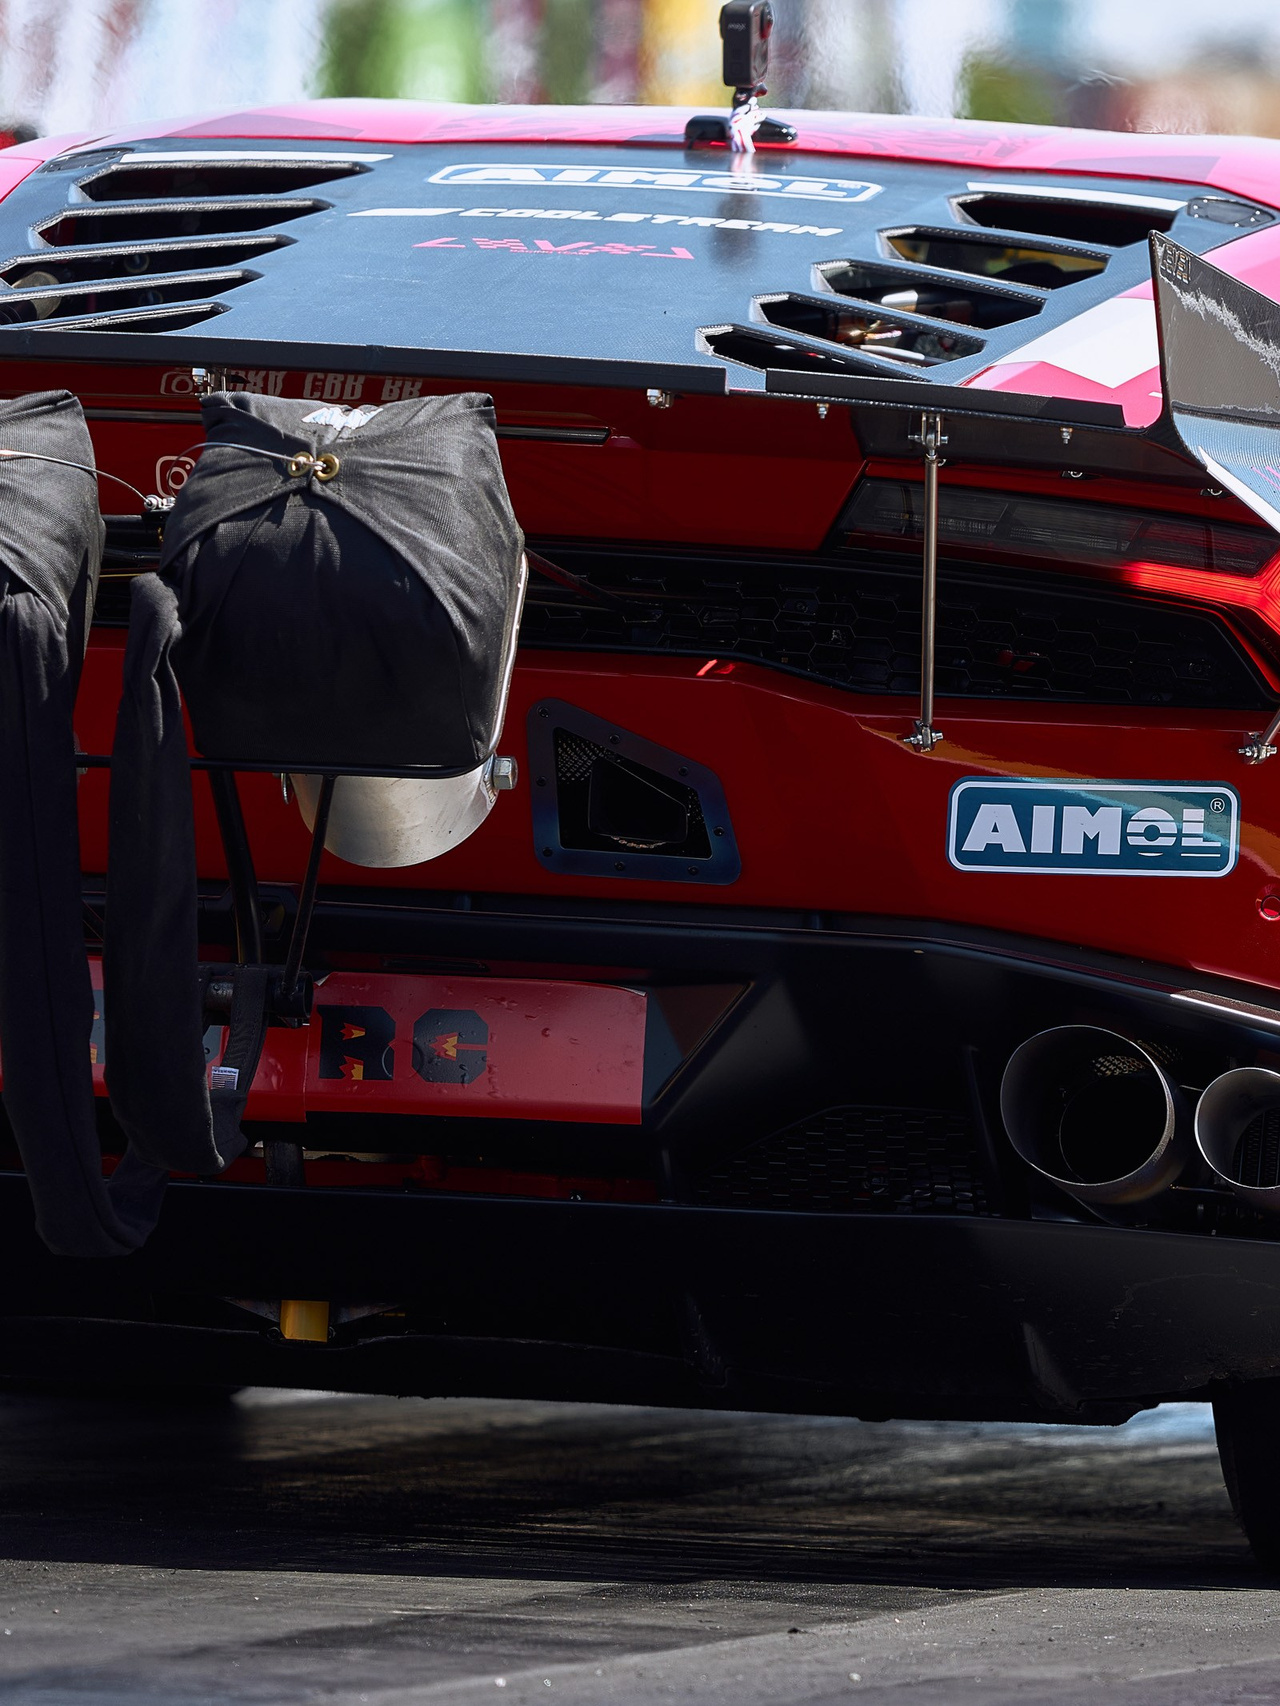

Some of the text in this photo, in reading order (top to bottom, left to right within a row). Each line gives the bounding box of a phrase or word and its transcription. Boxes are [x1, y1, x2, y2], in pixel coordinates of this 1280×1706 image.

[448, 167, 848, 198] AIMOL
[458, 207, 844, 237] COOLSTREAM
[961, 803, 1222, 857] AIMOL
